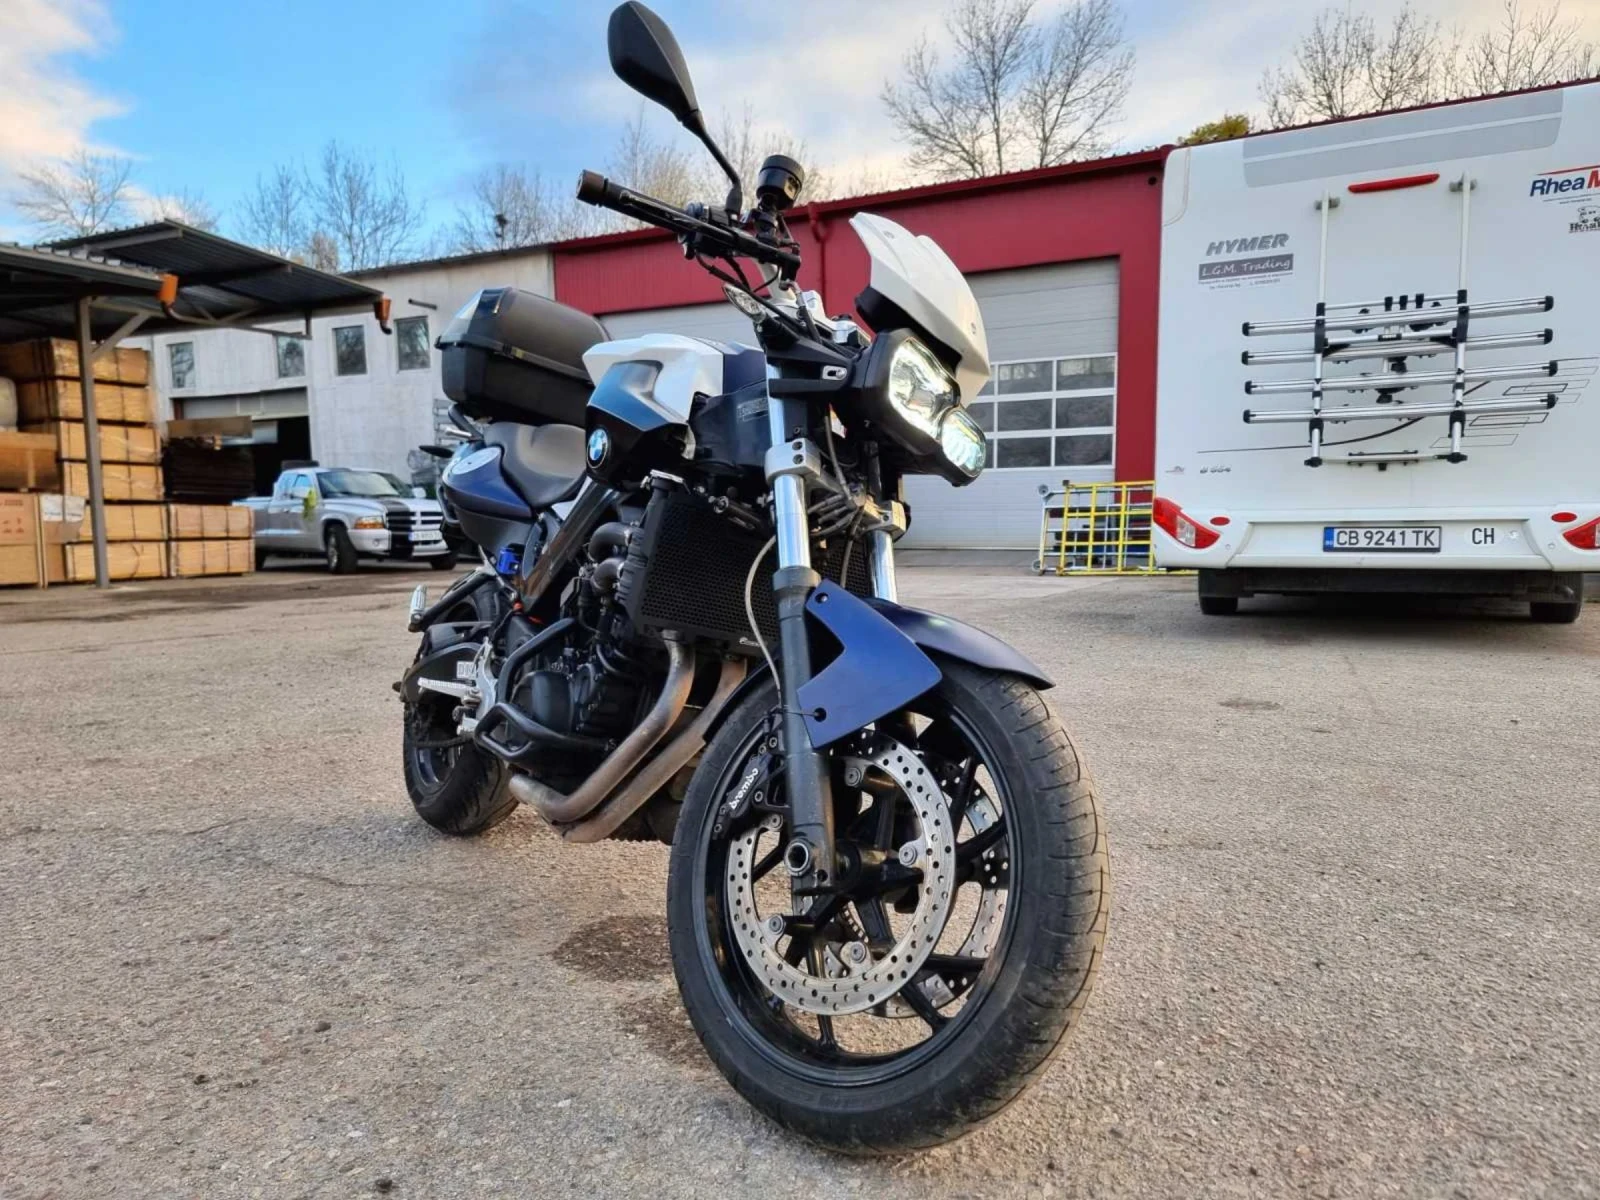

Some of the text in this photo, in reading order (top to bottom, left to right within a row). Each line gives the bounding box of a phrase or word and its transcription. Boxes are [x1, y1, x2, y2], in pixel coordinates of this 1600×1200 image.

[1206, 233, 1290, 256] HYMER
[1242, 259, 1291, 272] Trading
[1336, 530, 1435, 546] CB 9241 TK
[1472, 527, 1495, 545] CH
[729, 768, 759, 810] brembo
